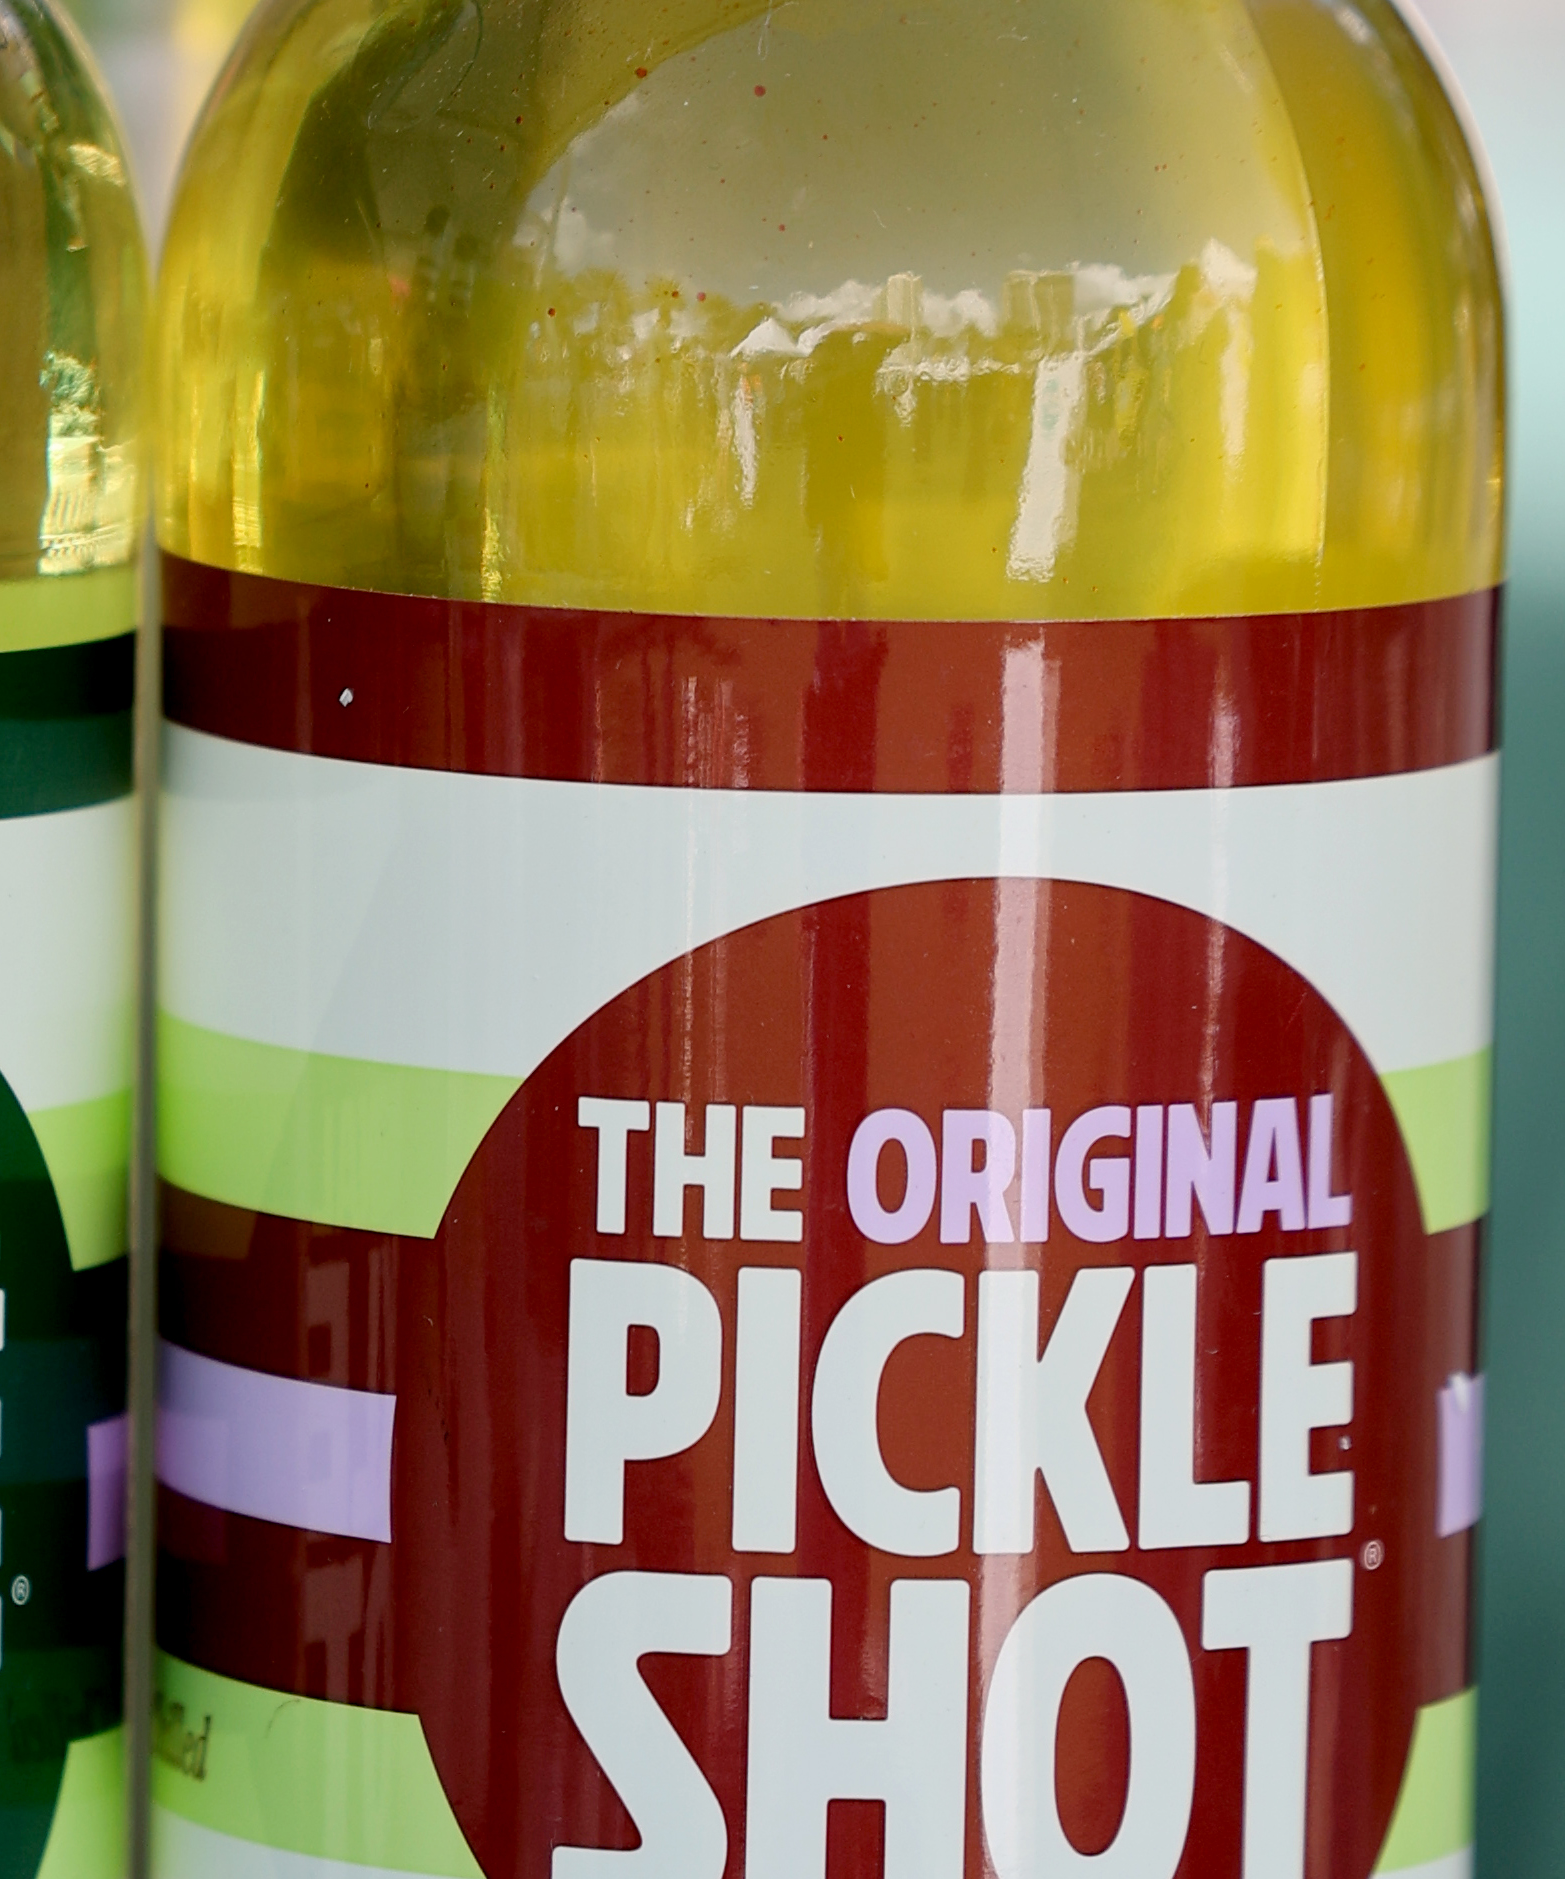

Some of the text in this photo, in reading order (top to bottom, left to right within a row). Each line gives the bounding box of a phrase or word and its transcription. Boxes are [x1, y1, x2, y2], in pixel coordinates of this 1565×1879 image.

[578, 1093, 1351, 1244] THE ORIGINAL
[564, 1250, 1358, 1557] PICKLE
